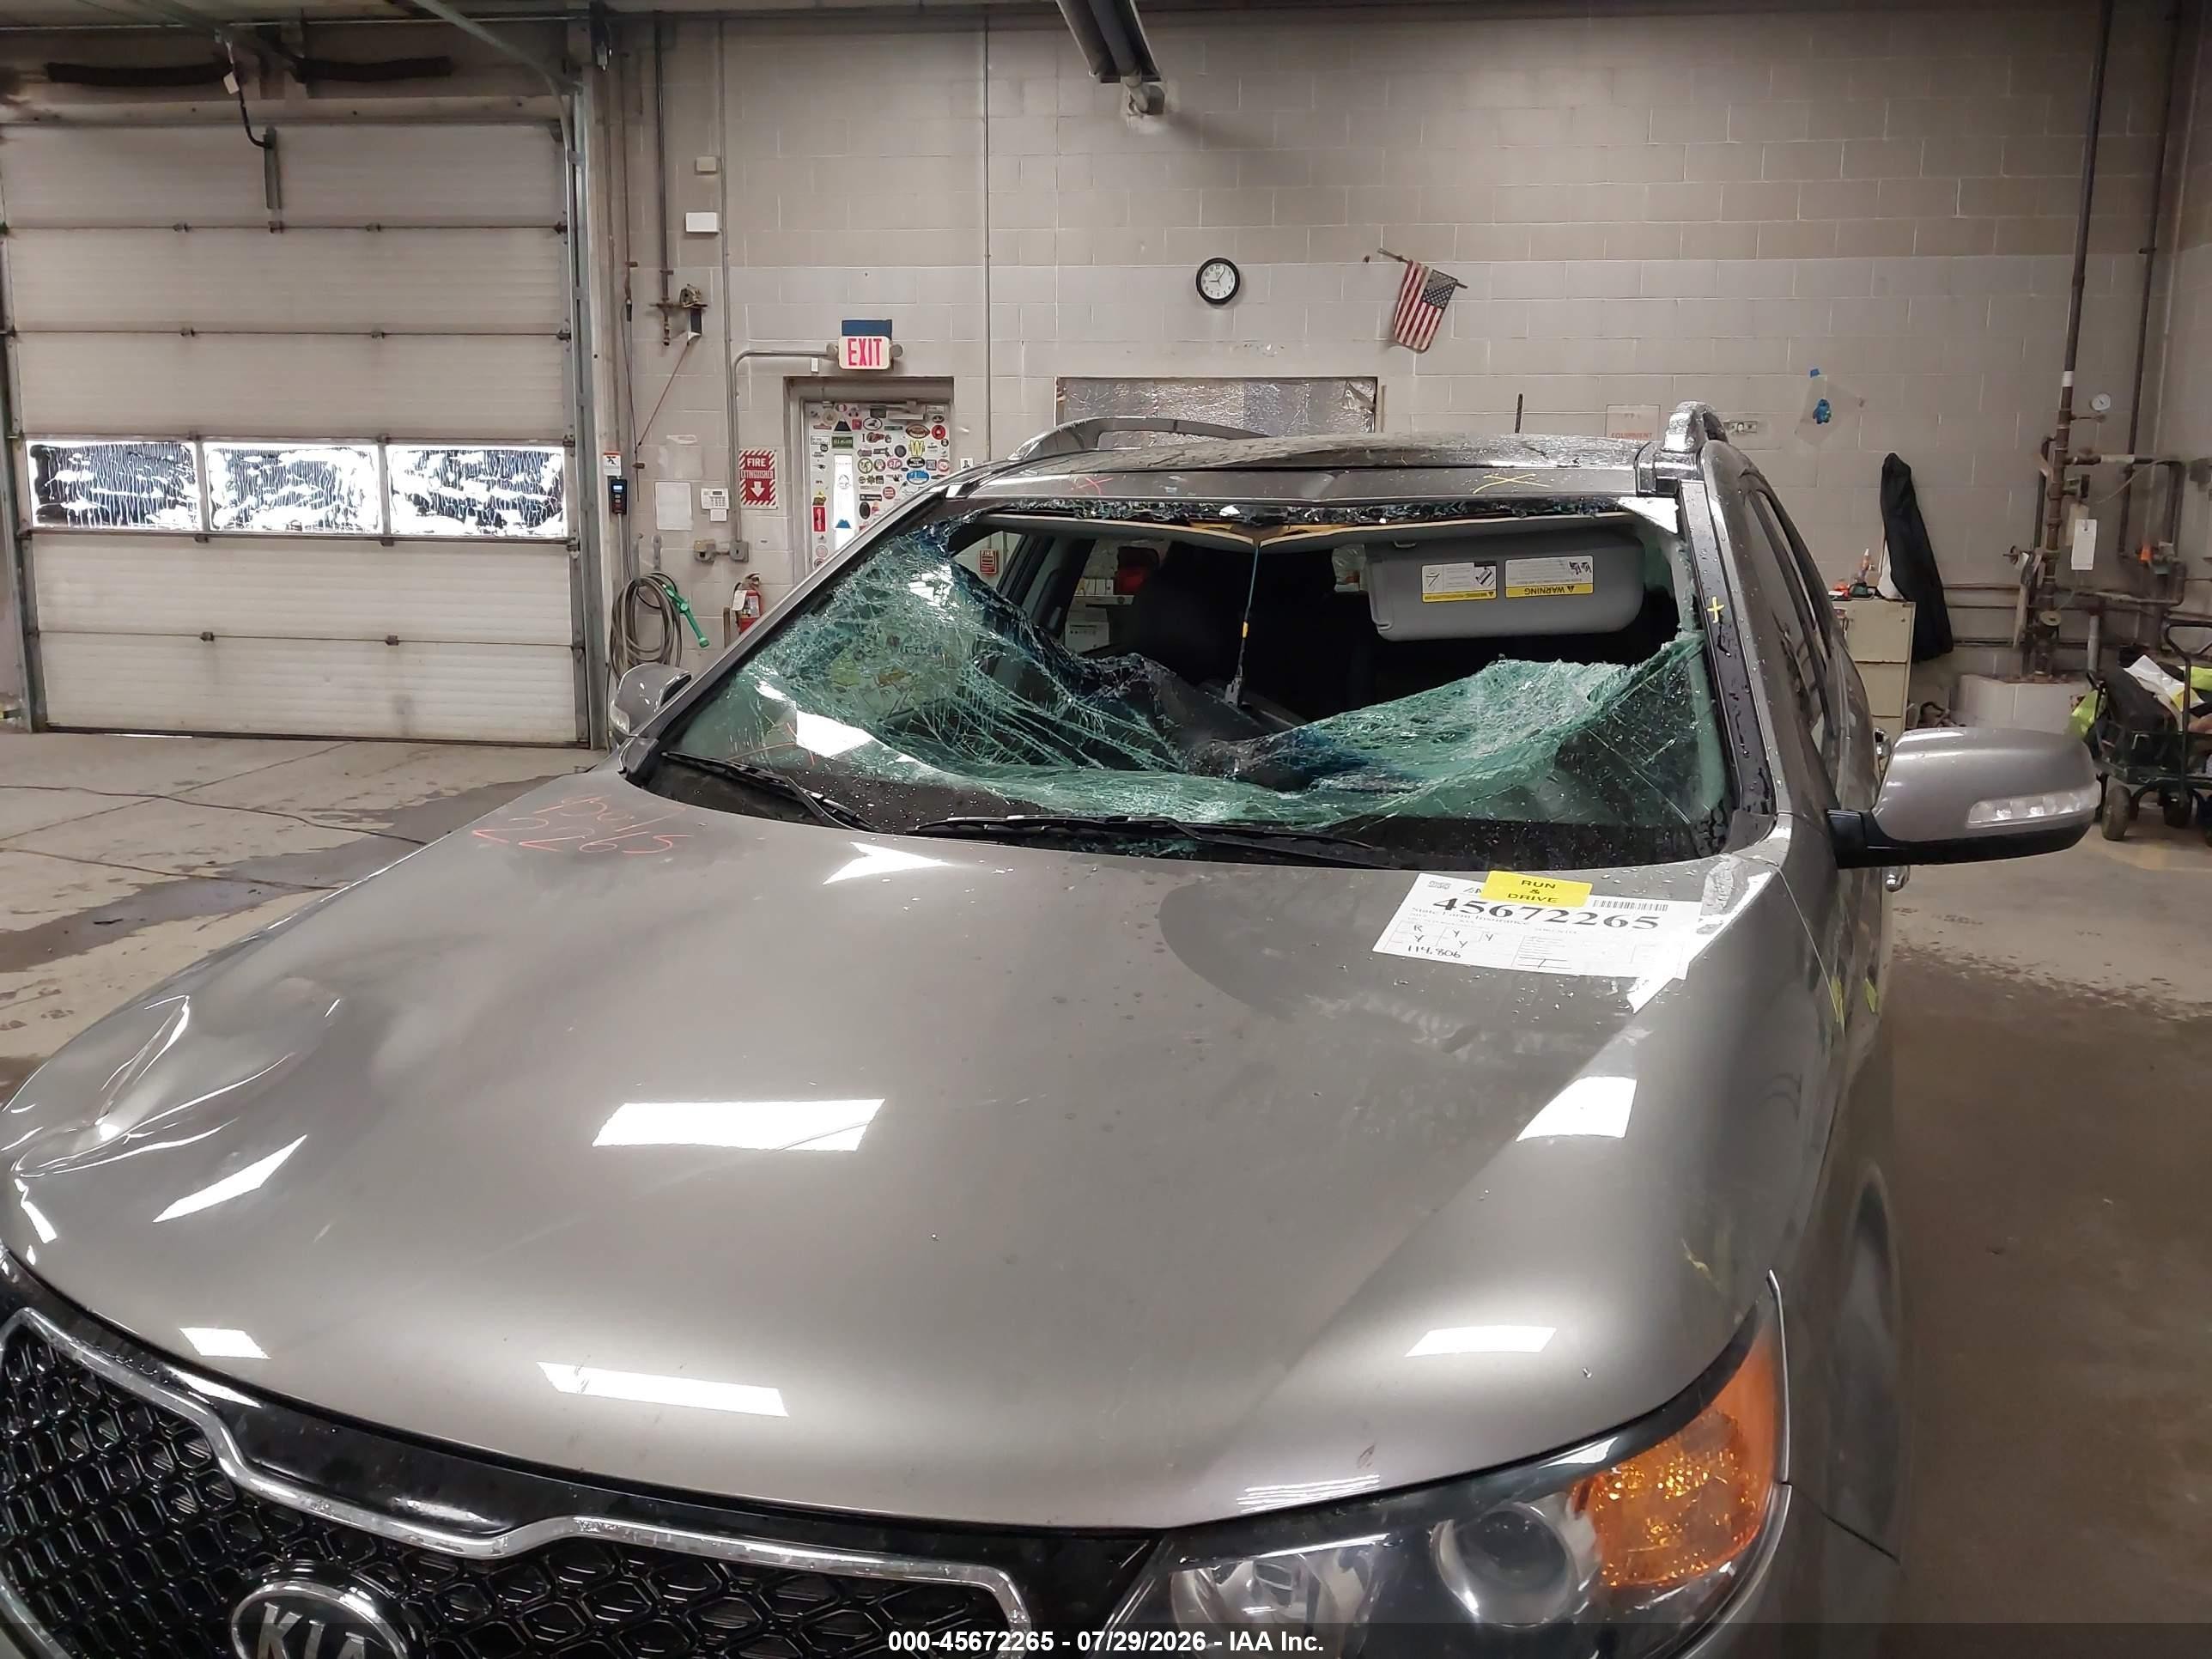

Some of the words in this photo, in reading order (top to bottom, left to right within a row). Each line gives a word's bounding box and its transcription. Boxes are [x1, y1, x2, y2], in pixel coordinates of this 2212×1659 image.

[848, 337, 883, 367] EXIT
[746, 457, 767, 467] FIRE
[740, 469, 774, 479] EXTINGUISHER
[1524, 586, 1565, 595] WARNING
[1521, 879, 1557, 890] RUN
[1507, 893, 1560, 903] DRIVE
[1432, 897, 1661, 930] 45672265
